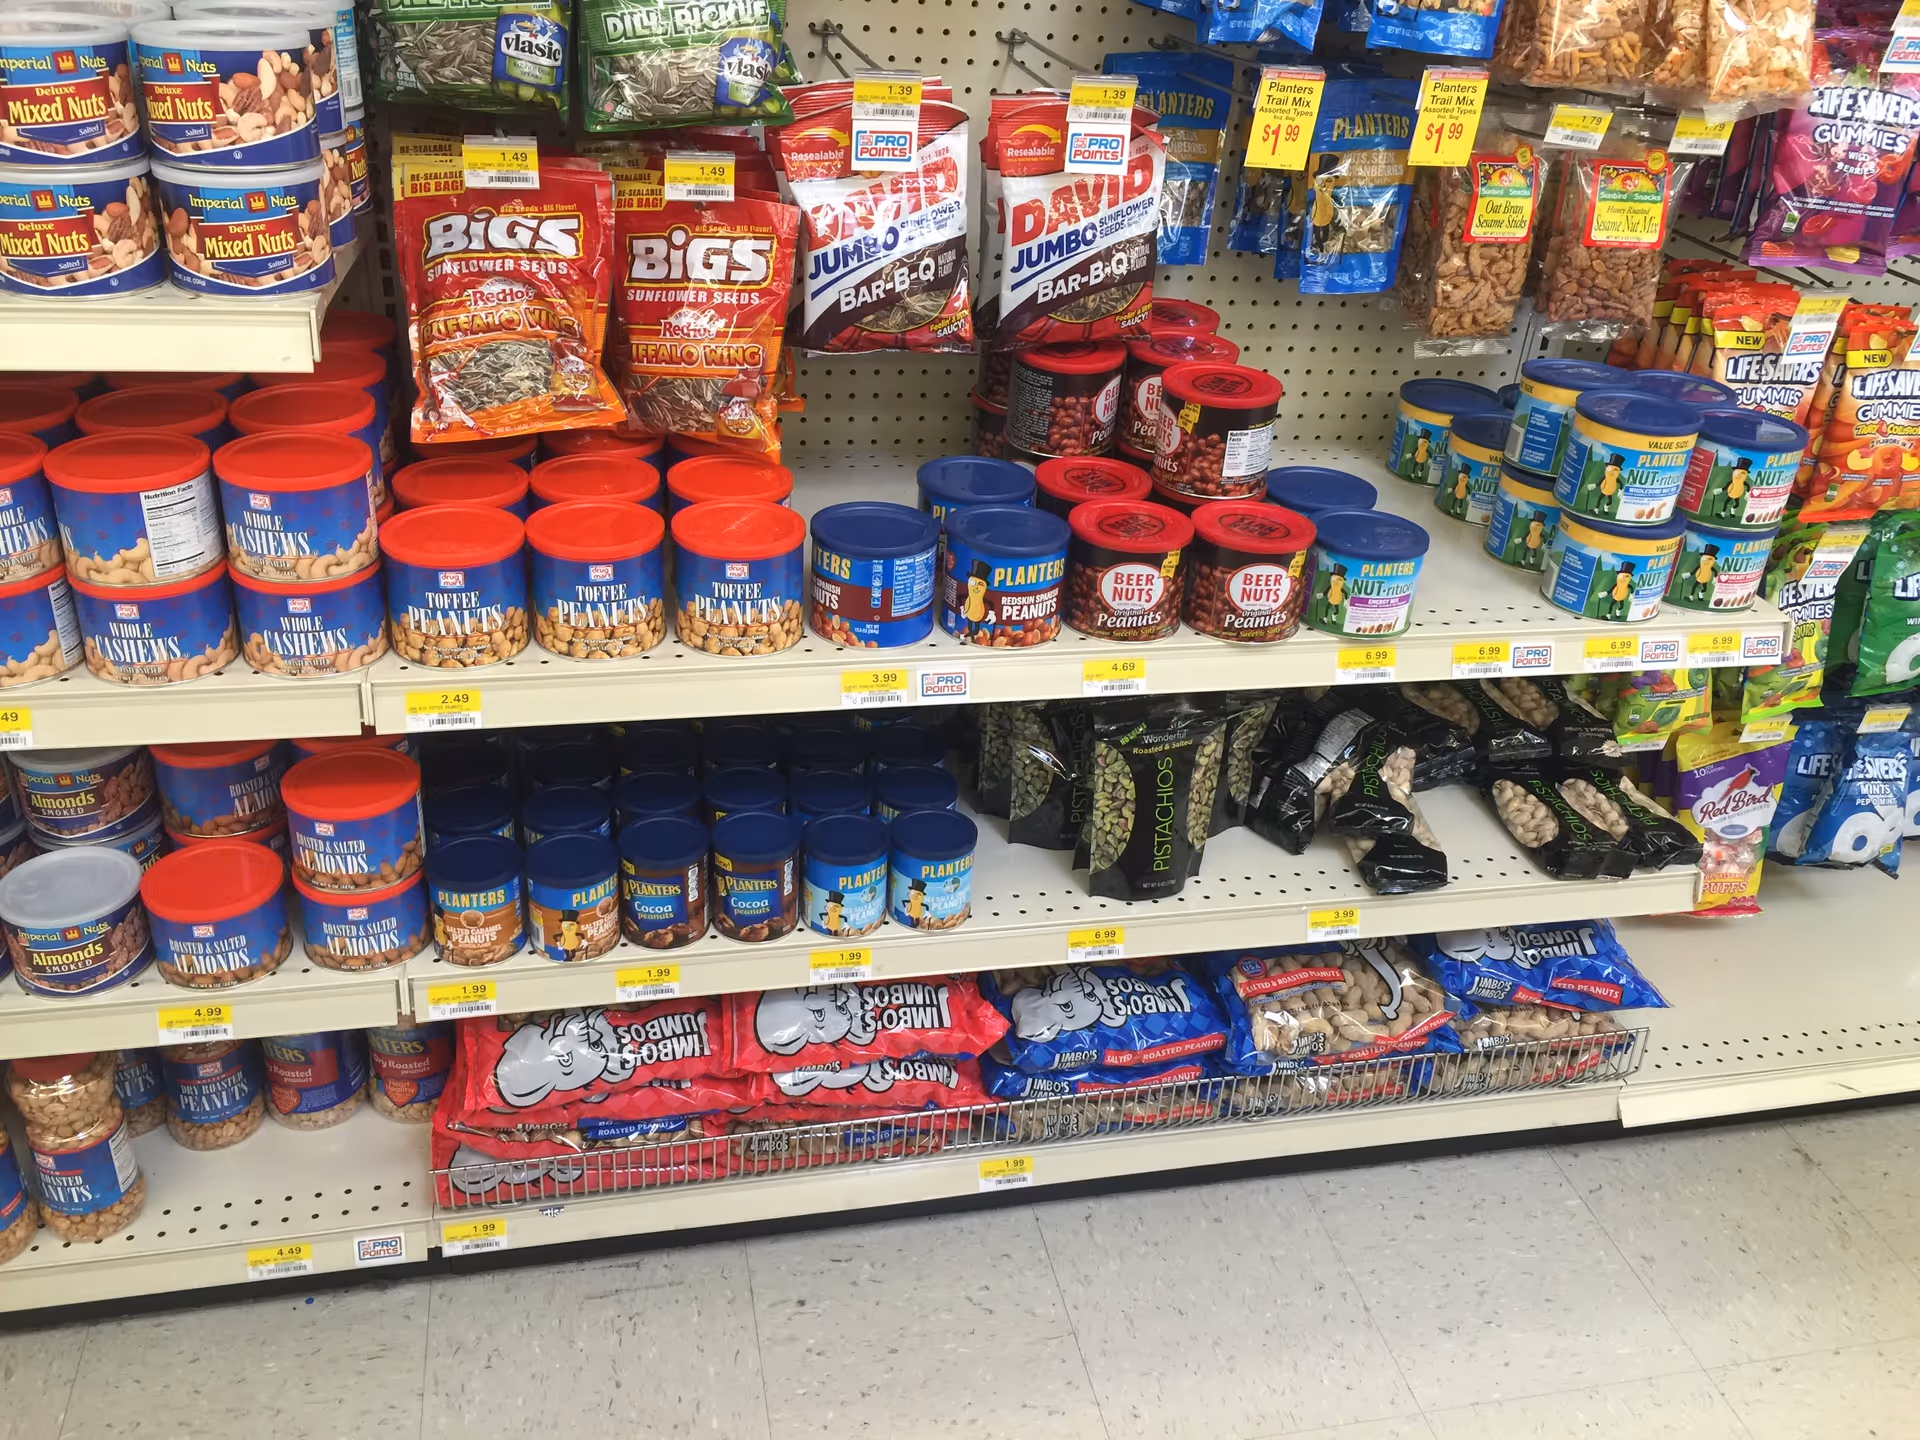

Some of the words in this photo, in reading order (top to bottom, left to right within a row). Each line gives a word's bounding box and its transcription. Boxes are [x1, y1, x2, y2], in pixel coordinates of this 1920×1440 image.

[503, 33, 562, 63] vlasic
[186, 60, 216, 74] Nuts
[35, 84, 76, 96] Deluxe
[155, 85, 182, 96] Deluxe
[887, 85, 913, 96] 1.39
[1268, 82, 1315, 95] Planters
[1433, 81, 1478, 94] Planters
[1102, 89, 1127, 100] 1.39
[1430, 95, 1452, 106] Trail
[1455, 96, 1475, 107] Mix
[8, 97, 63, 122] Mixed
[69, 94, 106, 119] Nuts
[1266, 95, 1288, 108] Trail
[1292, 97, 1311, 109] Mix
[1259, 106, 1288, 116] Assorted
[1290, 107, 1314, 118] Types
[1423, 106, 1451, 115] Assorted
[1452, 107, 1477, 116] Types
[79, 124, 100, 136] Salted
[185, 126, 204, 137] Salted
[1333, 115, 1410, 142] PLANTERS
[874, 134, 908, 147] PRO
[1088, 136, 1118, 150] PRO
[1814, 125, 1910, 155] GUMMIES
[500, 152, 528, 162] 1.49
[790, 148, 845, 162] Resealable
[860, 145, 908, 158] POINTS
[1006, 145, 1055, 158] Resealable
[1073, 147, 1119, 161] POINTS
[411, 171, 463, 181] RE-SEALABLE
[700, 167, 726, 176] 1.49
[411, 182, 431, 194] BIG
[434, 180, 466, 191] BAG!
[189, 193, 244, 211] Imperial
[270, 194, 296, 207] Nuts
[615, 198, 634, 209] BIG
[637, 197, 664, 208] BAG!
[1012, 156, 1154, 247] DAVID
[1485, 200, 1502, 214] Oat
[1504, 202, 1524, 214] Bran
[17, 222, 54, 233] Deluxe
[229, 222, 266, 235] Deluxe
[1475, 214, 1505, 229] Sesame
[1506, 216, 1528, 230] Sticks
[1594, 215, 1622, 234] Sesame
[1624, 217, 1639, 233] Nut
[1640, 219, 1660, 234] Mix
[0, 233, 50, 256] Mixed
[53, 231, 89, 255] Nuts
[204, 236, 256, 260] Mixed
[258, 231, 294, 256] Nuts
[1010, 222, 1098, 274] JUMBO
[808, 226, 900, 280] JUMBO
[58, 259, 80, 270] Salted
[267, 257, 288, 269] Salted
[839, 254, 936, 313] BAR-B-Q
[627, 289, 708, 303] SUNFLOWER
[712, 291, 762, 305] SEEDS
[1736, 336, 1761, 346] NEW
[1802, 333, 1827, 344] PRO
[1790, 343, 1824, 353] POINTS
[1864, 354, 1887, 363] NEW
[1648, 440, 1672, 450] VALUE
[1674, 440, 1689, 450] SIZE
[243, 510, 283, 531] WHOLE
[590, 566, 612, 575] drug
[726, 563, 746, 572] drug
[994, 557, 1065, 588] PLANTERS
[1361, 562, 1415, 578] PLANTERS
[440, 572, 461, 582] drug
[1114, 572, 1155, 586] BEER
[1241, 573, 1284, 587] BEER
[575, 583, 627, 603] TOFFEE
[711, 581, 761, 600] TOFFEE
[1001, 594, 1034, 606] REDSKIN
[1035, 587, 1059, 604] SPANISH
[1112, 587, 1154, 603] NUTS
[1240, 588, 1283, 604] NUTS
[424, 590, 480, 610] TOFFEE
[557, 594, 646, 629] PEANUTS
[694, 592, 781, 626] PEANUTS
[1002, 598, 1058, 620] PEANUTS
[1114, 607, 1145, 617] Original
[1241, 608, 1273, 617] Original
[280, 615, 323, 632] WHOLE
[407, 603, 504, 637] PEANUTS
[1097, 611, 1161, 628] Peanuts
[1224, 611, 1287, 628] Peanuts
[109, 622, 152, 639] WHOLE
[264, 628, 347, 657] CASHEWS
[1611, 641, 1632, 650] 6.99
[1654, 642, 1677, 653] PRO
[1712, 636, 1734, 646] 6.99
[1755, 638, 1778, 648] PRO
[95, 633, 181, 663] CASHEWS
[1479, 646, 1501, 657] 6.99
[1526, 648, 1549, 658] PRO
[1366, 650, 1389, 661] 6.99
[1111, 662, 1136, 674] 4.69
[872, 673, 898, 683] 3.99
[935, 675, 963, 685] PRO
[924, 684, 963, 694] POINTS
[441, 694, 469, 705] 2.49
[1693, 768, 1706, 779] 10
[1860, 784, 1891, 795] MINTS
[30, 792, 96, 810] Almonds
[1700, 799, 1729, 823] Red
[1729, 784, 1775, 812] Bird
[41, 806, 84, 818] SMOKED
[1153, 757, 1173, 871] PISTACHIOS
[629, 879, 681, 896] PLANTERS
[725, 874, 778, 892] PLANTERS
[438, 889, 505, 909] PLANTERS
[730, 896, 770, 909] Cocoa
[634, 901, 672, 914] Cocoa
[733, 906, 771, 916] peanuts
[636, 912, 674, 922] peanuts
[1334, 910, 1355, 920] 3.99
[17, 928, 60, 943] Imperial
[84, 920, 109, 936] Nuts
[452, 931, 498, 943] PEANUTS
[1095, 930, 1116, 940] 6.99
[168, 936, 204, 956] ROASTED
[205, 941, 213, 955] &
[214, 934, 246, 952] SALTED
[324, 928, 401, 959] ALMONDS
[33, 944, 104, 967] Almonds
[173, 948, 250, 976] ALMONDS
[839, 952, 862, 962] 1.99
[45, 960, 93, 974] SMOKED
[647, 968, 671, 979] 1.99
[1278, 971, 1309, 987] ROASTED
[1309, 969, 1341, 979] PEANUTS
[461, 984, 487, 995] 1.99
[194, 1006, 222, 1018] 4.99
[617, 1011, 708, 1042] JUMBOS
[619, 1033, 712, 1068] JIMBO'S
[1143, 1046, 1183, 1061] ROASTED
[1185, 1039, 1225, 1052] PEANUTS
[372, 1053, 388, 1068] Dry
[389, 1056, 430, 1070] Roasted
[276, 1068, 312, 1080] Roasted
[401, 1064, 430, 1076] peanuts
[180, 1085, 200, 1100] DRY
[201, 1071, 244, 1096] ROASTED
[1005, 1159, 1025, 1169] 1.99
[473, 1223, 496, 1232] 1.99
[372, 1240, 398, 1250] PRO
[276, 1247, 302, 1258] 4.49
[361, 1248, 402, 1258] POINTS
